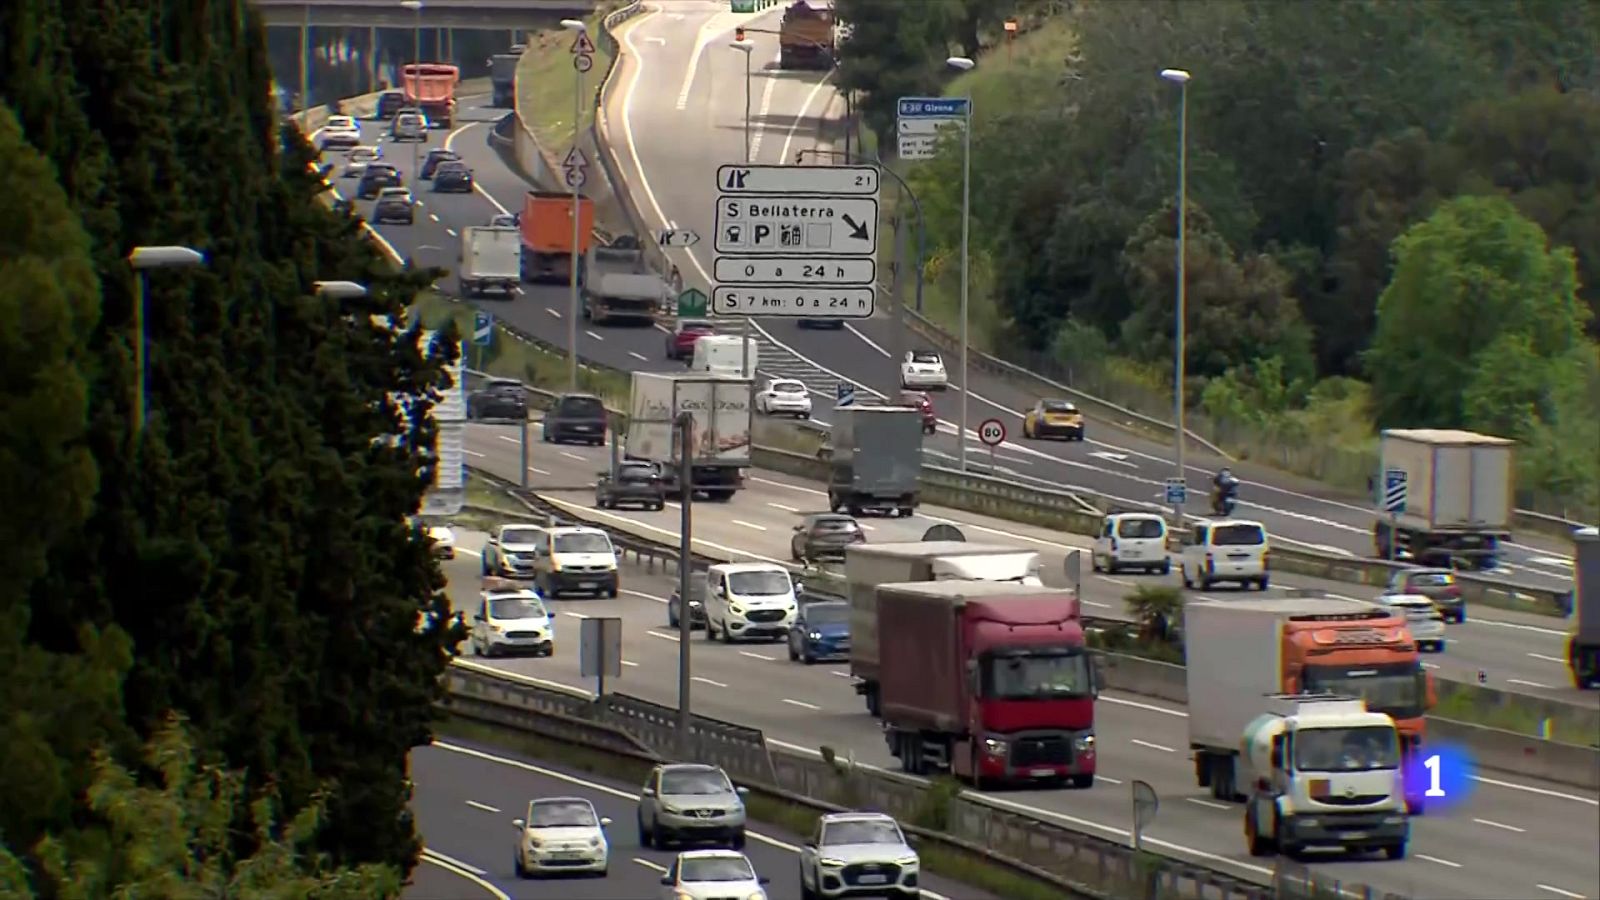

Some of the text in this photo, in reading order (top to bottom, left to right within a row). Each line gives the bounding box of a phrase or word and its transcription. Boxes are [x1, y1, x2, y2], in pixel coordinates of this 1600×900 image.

[924, 103, 953, 112] Girona
[854, 176, 871, 186] 21
[727, 203, 834, 217] S Bellaterra
[754, 225, 770, 244] P
[744, 265, 844, 277] 0 a 24 h
[726, 294, 738, 308] S
[747, 297, 755, 307] 7
[795, 297, 805, 307] 0
[813, 299, 820, 307] a
[829, 298, 848, 308] 24
[858, 298, 865, 308] h
[984, 428, 1001, 437] 80
